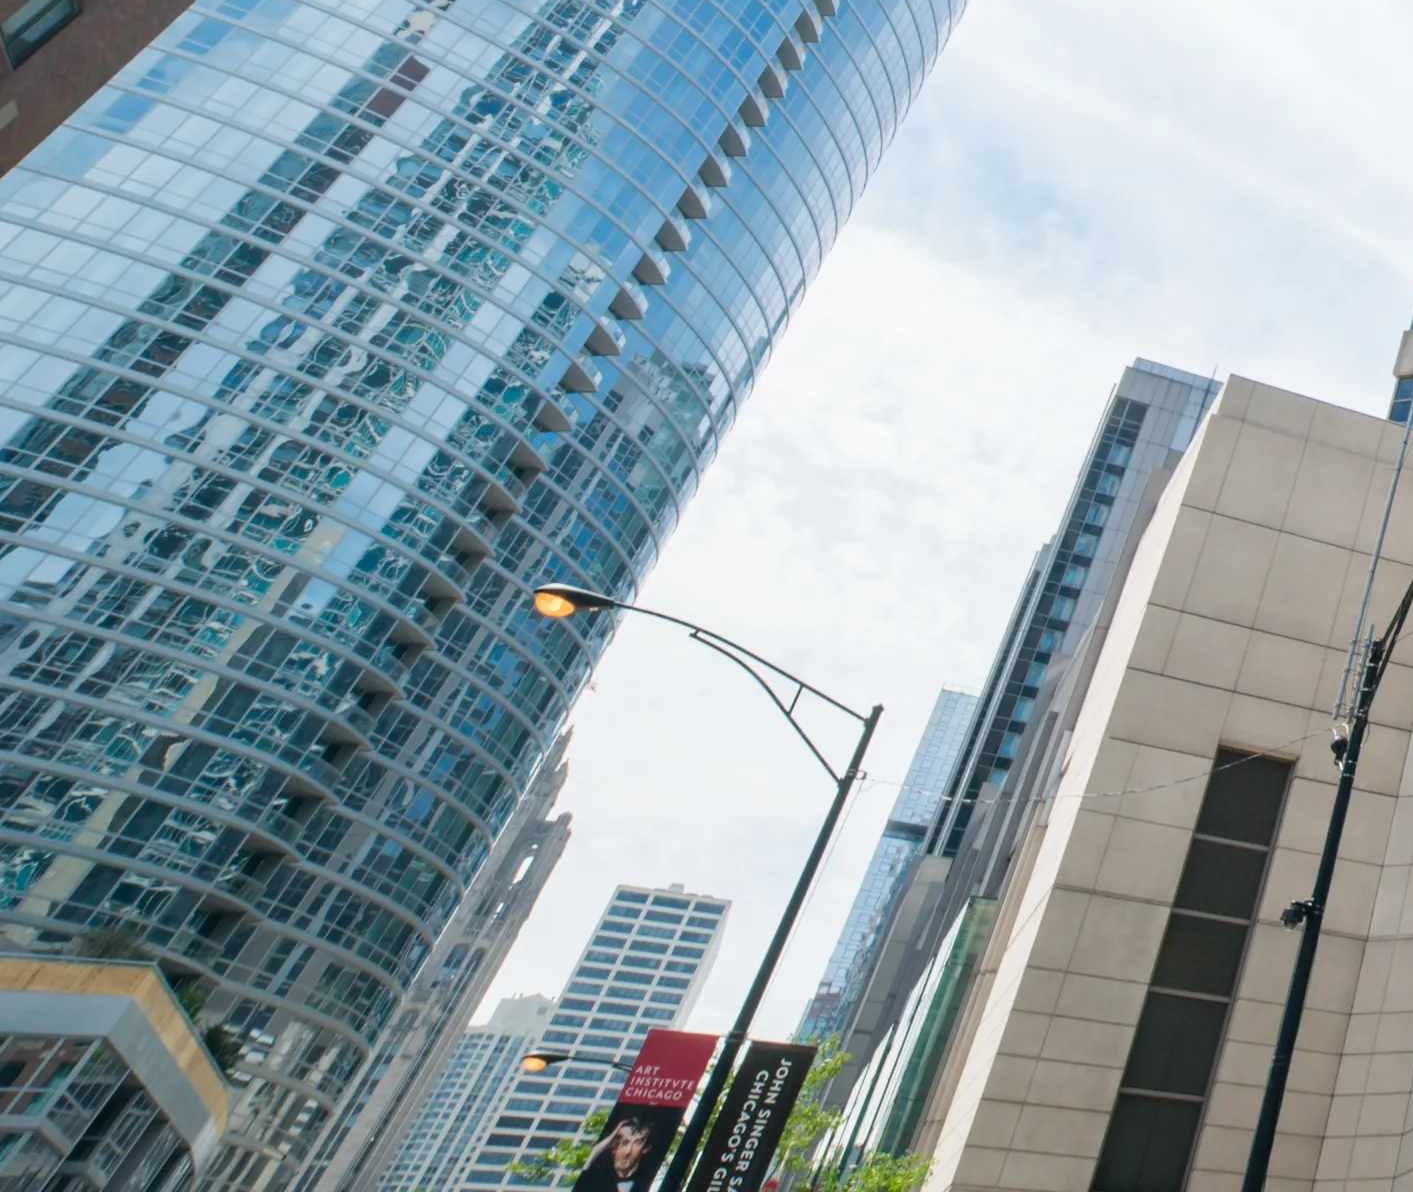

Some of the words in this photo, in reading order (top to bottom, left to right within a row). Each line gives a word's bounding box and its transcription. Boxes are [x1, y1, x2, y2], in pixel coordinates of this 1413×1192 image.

[629, 1075, 695, 1090] INSTITVTE
[634, 1064, 661, 1076] ART
[764, 1057, 792, 1105] JOHN
[625, 1086, 683, 1101] CHICAGO
[721, 1070, 769, 1163] CHICAGO'S
[735, 1108, 771, 1173] SINGER
